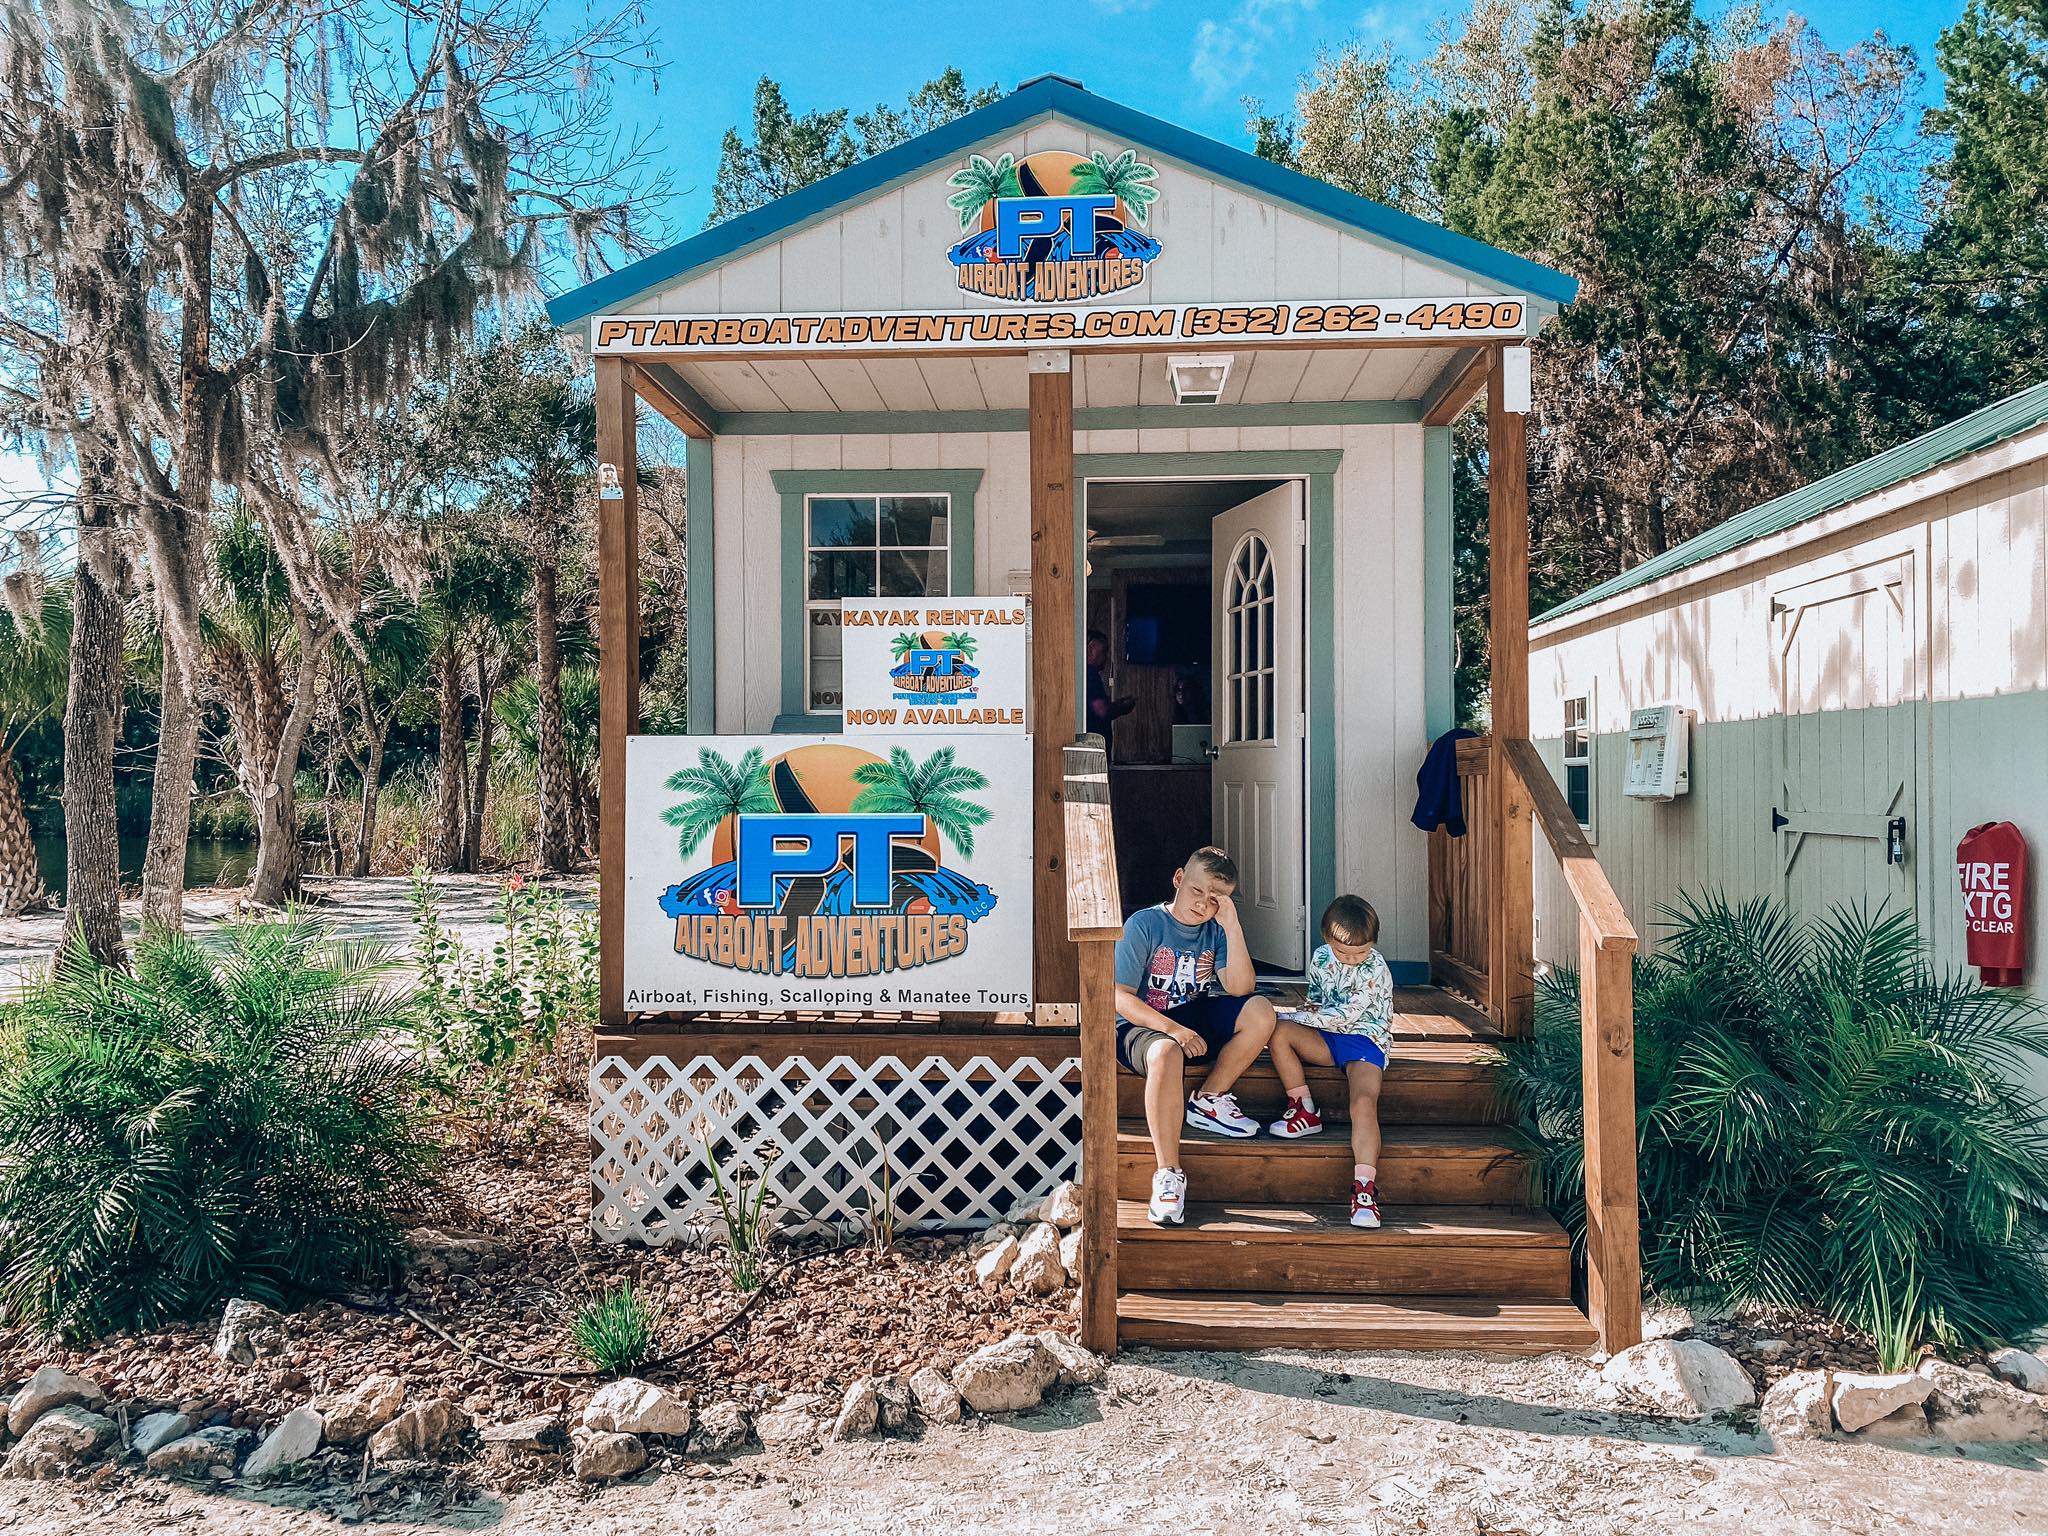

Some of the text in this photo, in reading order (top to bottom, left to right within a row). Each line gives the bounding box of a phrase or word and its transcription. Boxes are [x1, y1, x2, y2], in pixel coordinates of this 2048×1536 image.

[997, 194, 1117, 259] PT
[958, 258, 1144, 301] AIRBOAT ADVENTURES
[598, 310, 1174, 346] PTAIRBOATADVENTURES.COM
[1181, 304, 1289, 337] (352)
[843, 609, 1026, 626] KAYAK RENTALS
[910, 649, 961, 676] PT
[894, 675, 973, 693] AIRBOAT ADVENTURES
[846, 708, 1024, 725] NOW AVAILABLE
[736, 812, 927, 909] PT
[1957, 863, 2010, 890] FIRE
[970, 901, 988, 917] LLC
[1962, 891, 2012, 919] XTG
[1972, 920, 2014, 934] CLEAR
[673, 914, 969, 978] AIRBOAT ADVENTURES
[627, 988, 1028, 1006] Airboat, Fishing, Scalloping & Manatee Tours
